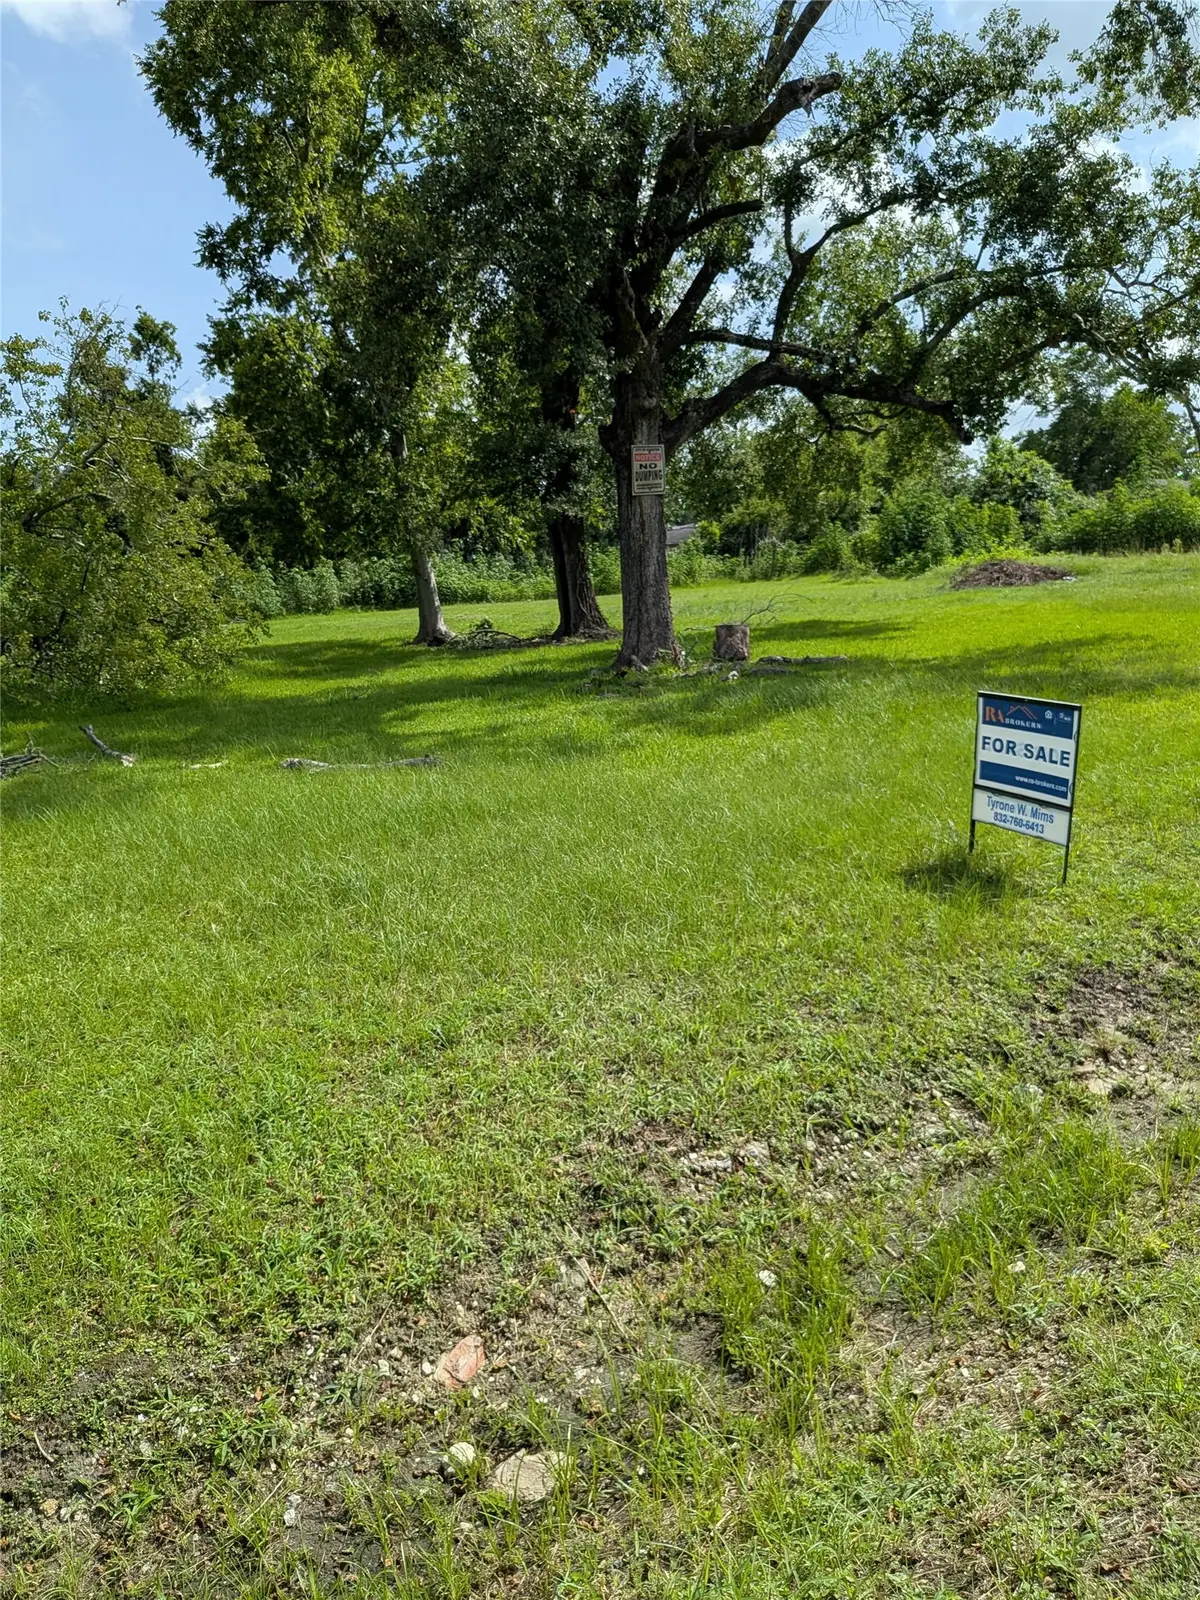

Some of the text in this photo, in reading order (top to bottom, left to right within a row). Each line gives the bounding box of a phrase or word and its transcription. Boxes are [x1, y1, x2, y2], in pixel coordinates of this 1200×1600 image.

[635, 469, 662, 482] DUMPING
[985, 706, 1004, 724] RA
[1004, 717, 1042, 729] BROKERS
[981, 735, 1071, 768] FOR SALE
[1015, 775, 1067, 793] www.ra-brokers.com
[987, 795, 1054, 824] Tyrone W. Mims
[993, 811, 1045, 834] 832-760-6413
